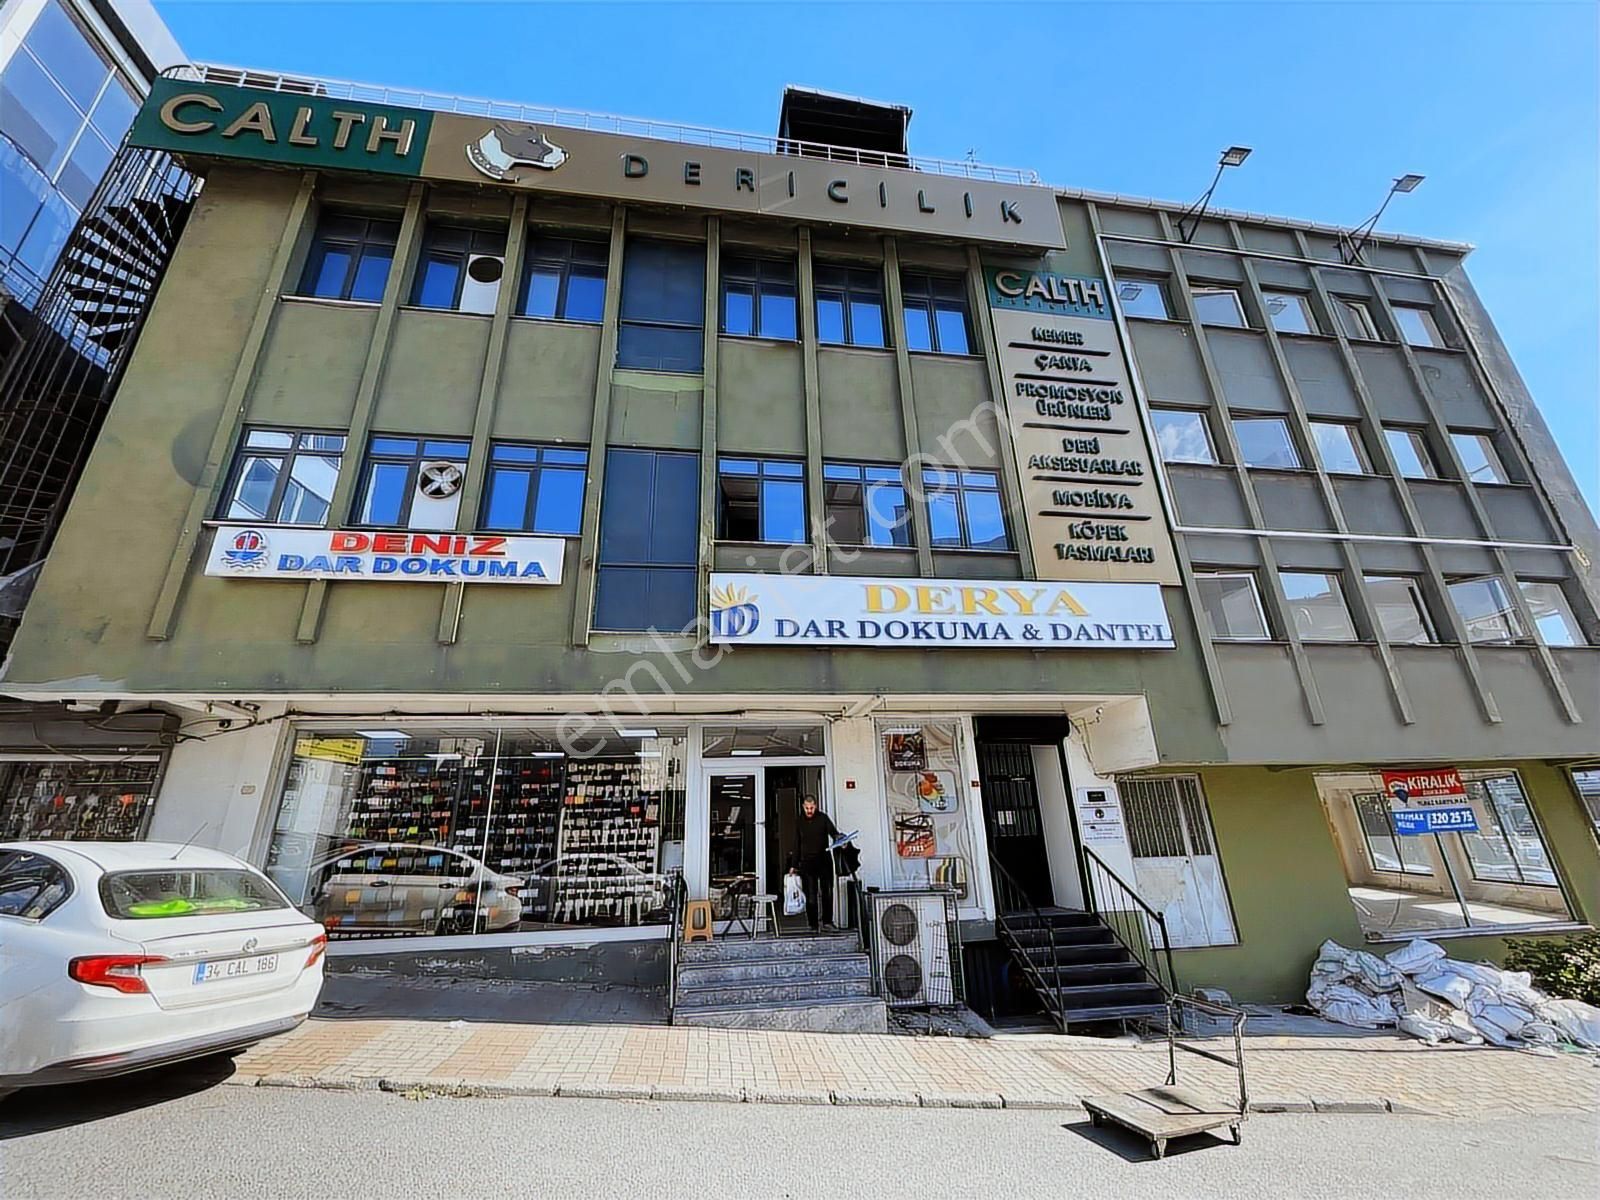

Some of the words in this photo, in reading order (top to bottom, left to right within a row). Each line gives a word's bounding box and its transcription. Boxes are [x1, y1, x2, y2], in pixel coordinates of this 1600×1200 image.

[159, 92, 416, 156] CALTH
[996, 272, 1105, 308] CALTH
[1031, 326, 1084, 346] KEMER
[1015, 382, 1124, 405] PROMOSYON
[1027, 454, 1144, 476] AKSESUARLAR
[1068, 520, 1129, 541] KÖPEK
[277, 554, 362, 574] DAR
[372, 555, 547, 578] DOKUMA
[861, 583, 1092, 617] DERYA
[774, 618, 850, 639] DAR
[857, 620, 1010, 641] DOKUMA
[1021, 623, 1044, 641] &
[1051, 623, 1175, 642] DANTEL
[1431, 812, 1449, 824] 320
[1461, 810, 1473, 822] 75
[206, 965, 220, 978] 34
[227, 960, 249, 976] CAL
